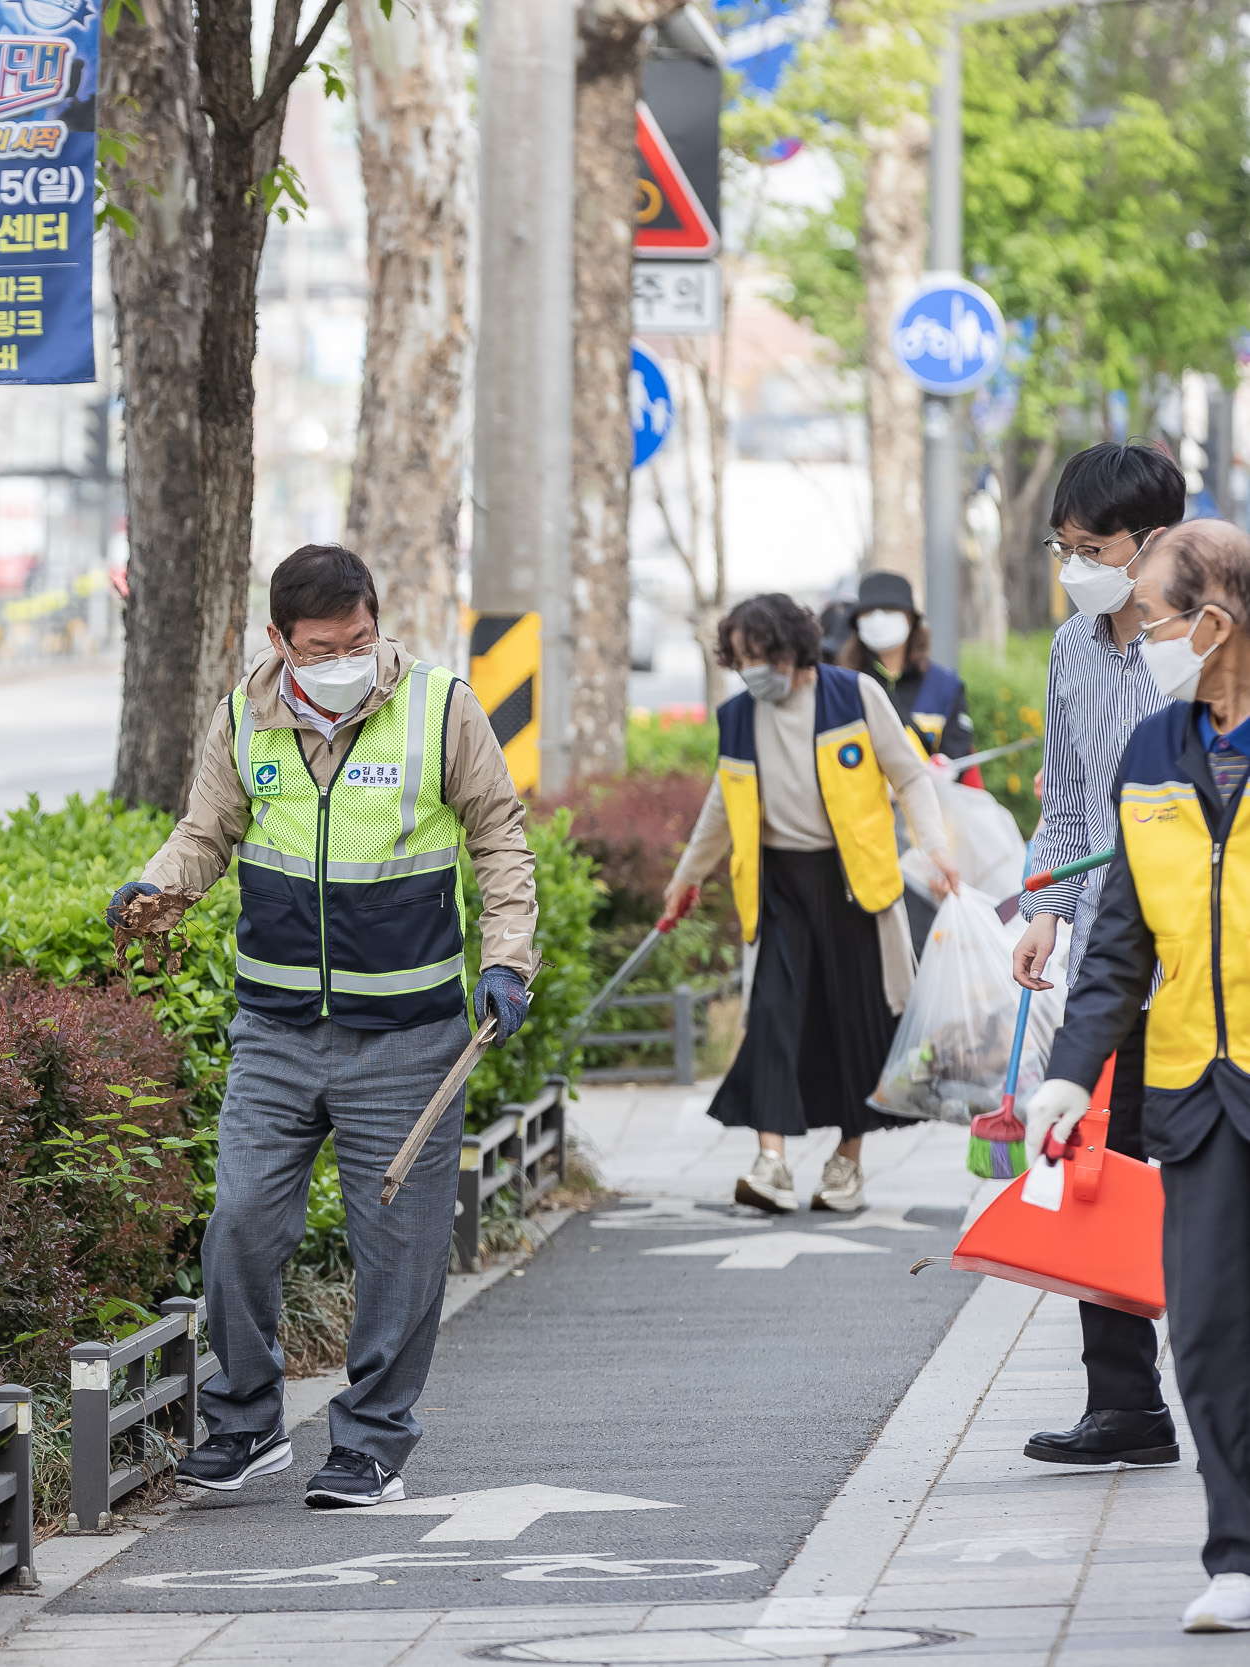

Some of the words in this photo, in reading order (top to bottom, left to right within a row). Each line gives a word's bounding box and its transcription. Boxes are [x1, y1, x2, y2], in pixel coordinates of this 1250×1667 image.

[11, 126, 61, 152] 시작
[361, 776, 398, 785] 광진구청장
[257, 785, 278, 793] 광진구
